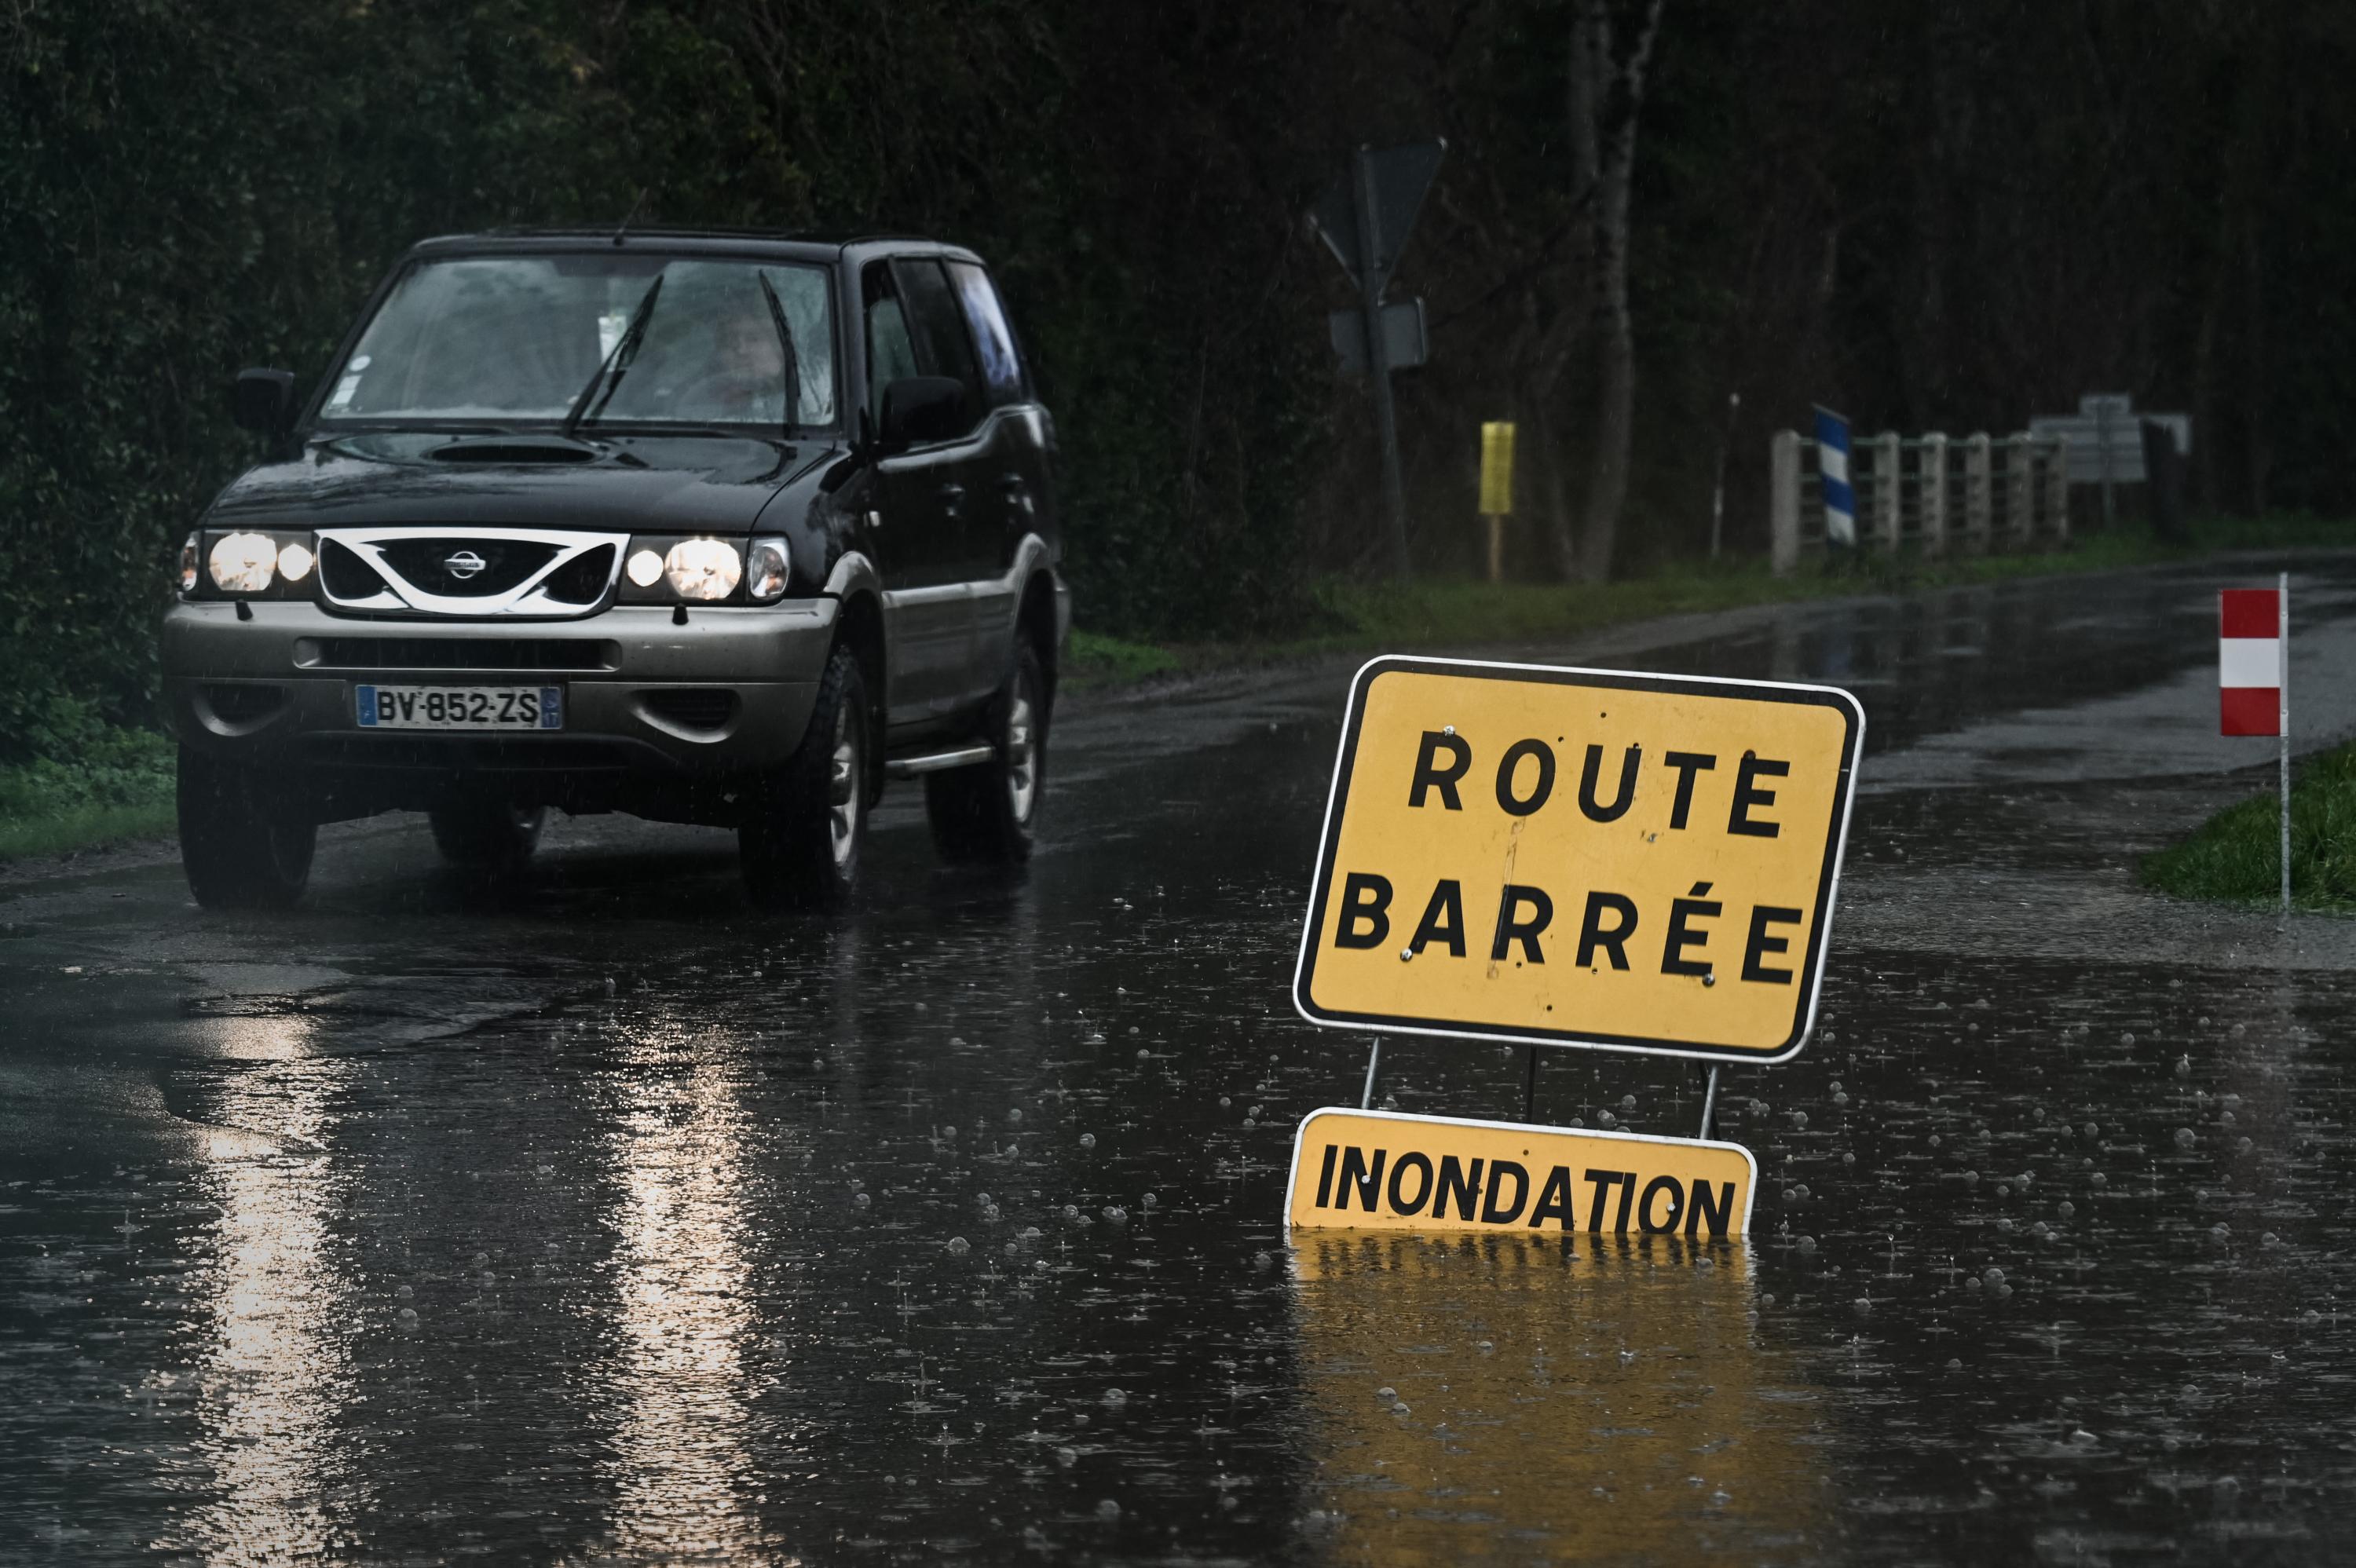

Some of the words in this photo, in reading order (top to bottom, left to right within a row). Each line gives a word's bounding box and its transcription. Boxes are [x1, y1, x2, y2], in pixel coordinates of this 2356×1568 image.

[377, 691, 539, 722] BV-852-ZS
[1408, 730, 1791, 839] ROUTE
[1334, 872, 1803, 985] BARRÉE
[1315, 1143, 1736, 1234] INONDATION
